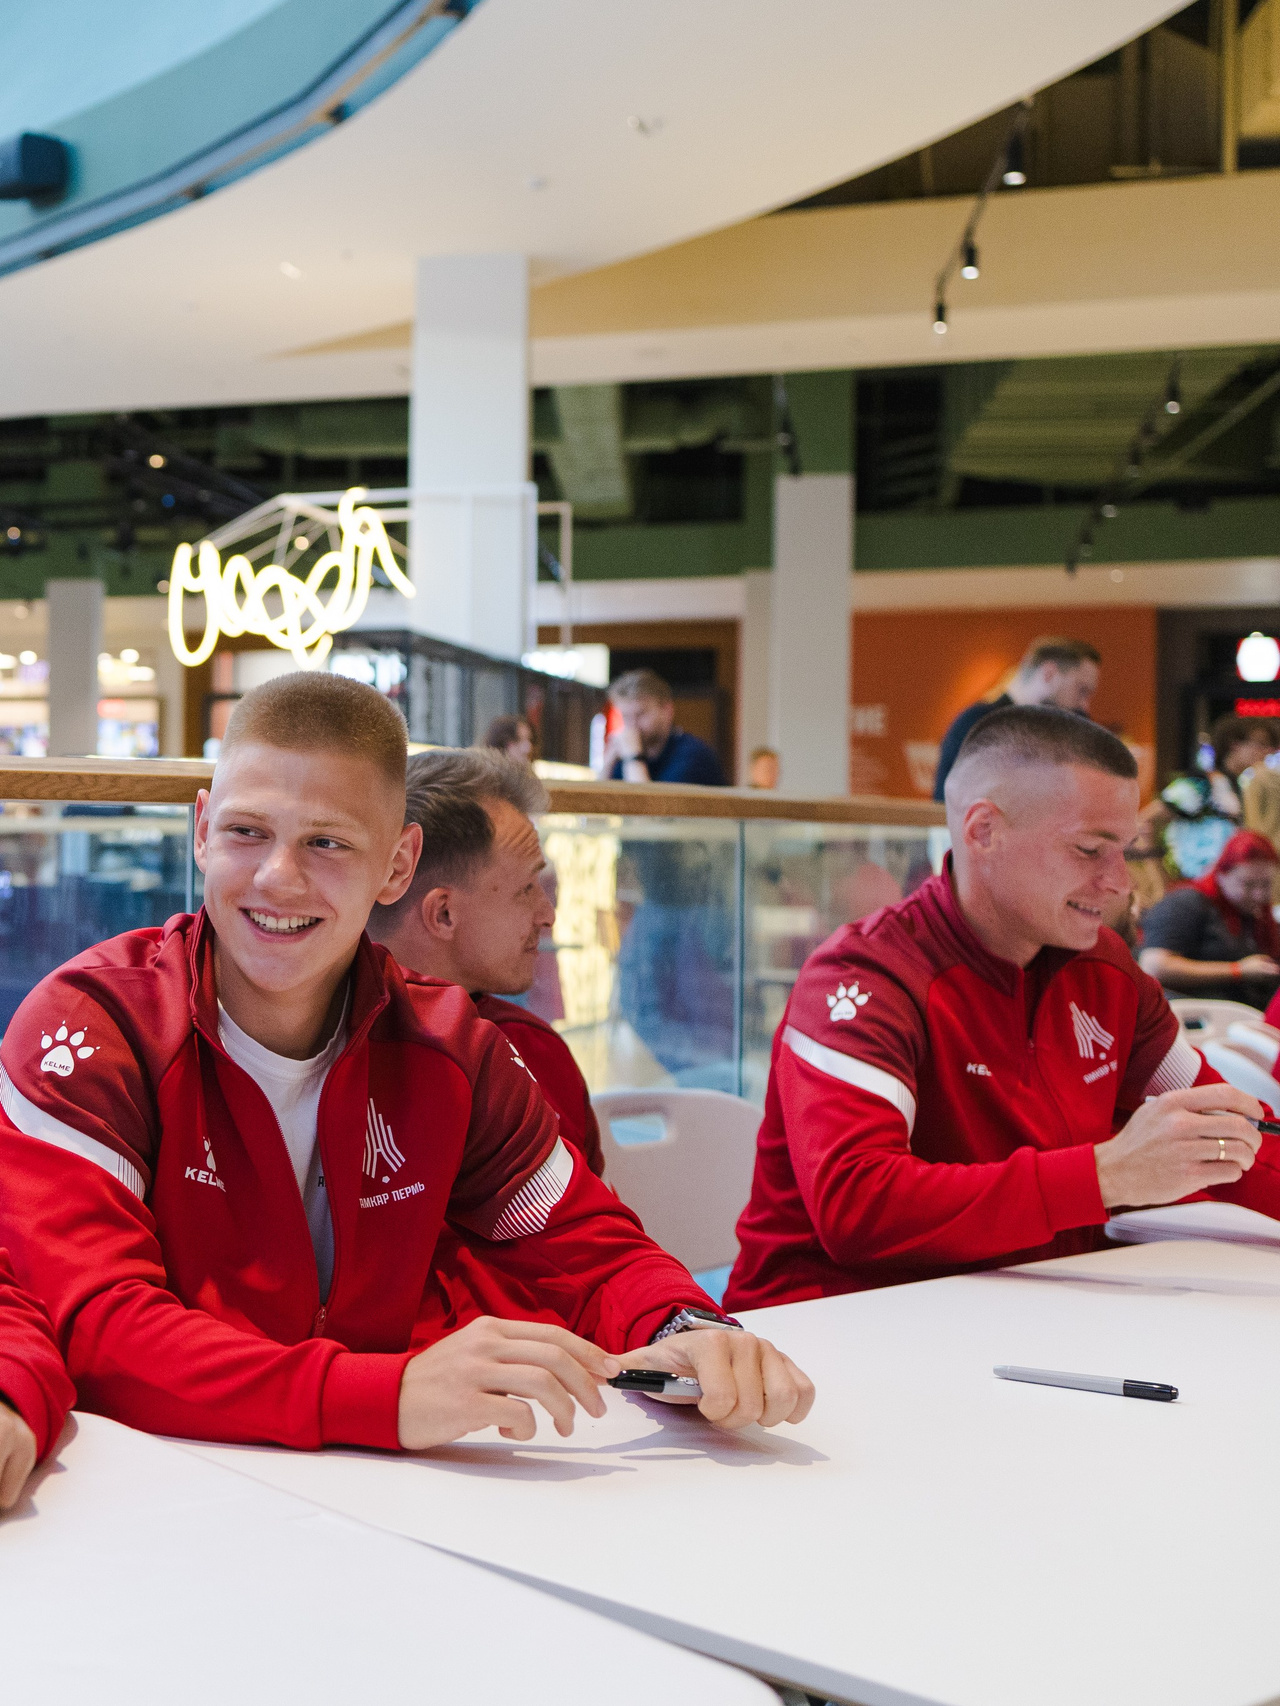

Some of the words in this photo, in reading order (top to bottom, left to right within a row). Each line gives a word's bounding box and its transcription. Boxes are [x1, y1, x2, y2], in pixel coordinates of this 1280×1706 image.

[43, 1060, 71, 1072] KELME
[359, 1193, 390, 1209] АМКАР
[391, 1181, 426, 1202] ПЕРМЬ
